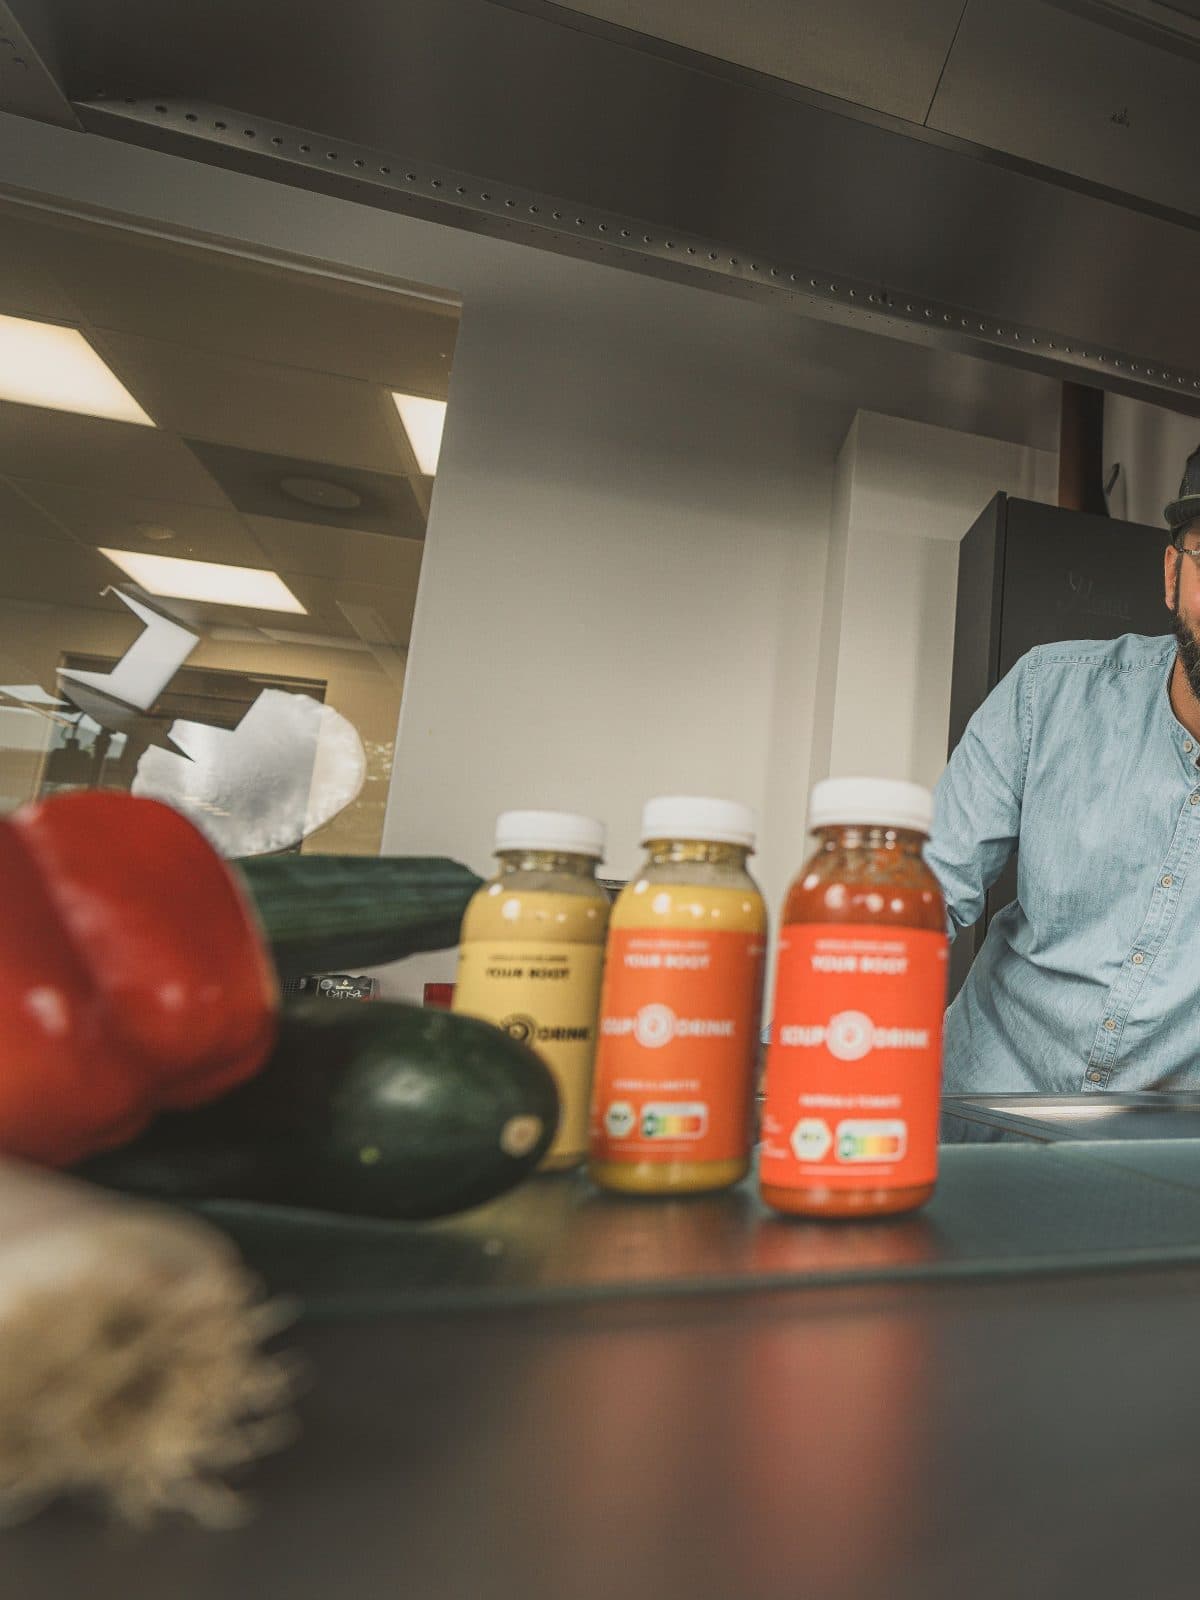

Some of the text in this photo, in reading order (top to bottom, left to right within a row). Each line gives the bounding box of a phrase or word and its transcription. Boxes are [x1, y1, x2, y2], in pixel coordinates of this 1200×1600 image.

[624, 954, 710, 970] YOUR ROOT
[811, 955, 907, 975] YOUR ROOT
